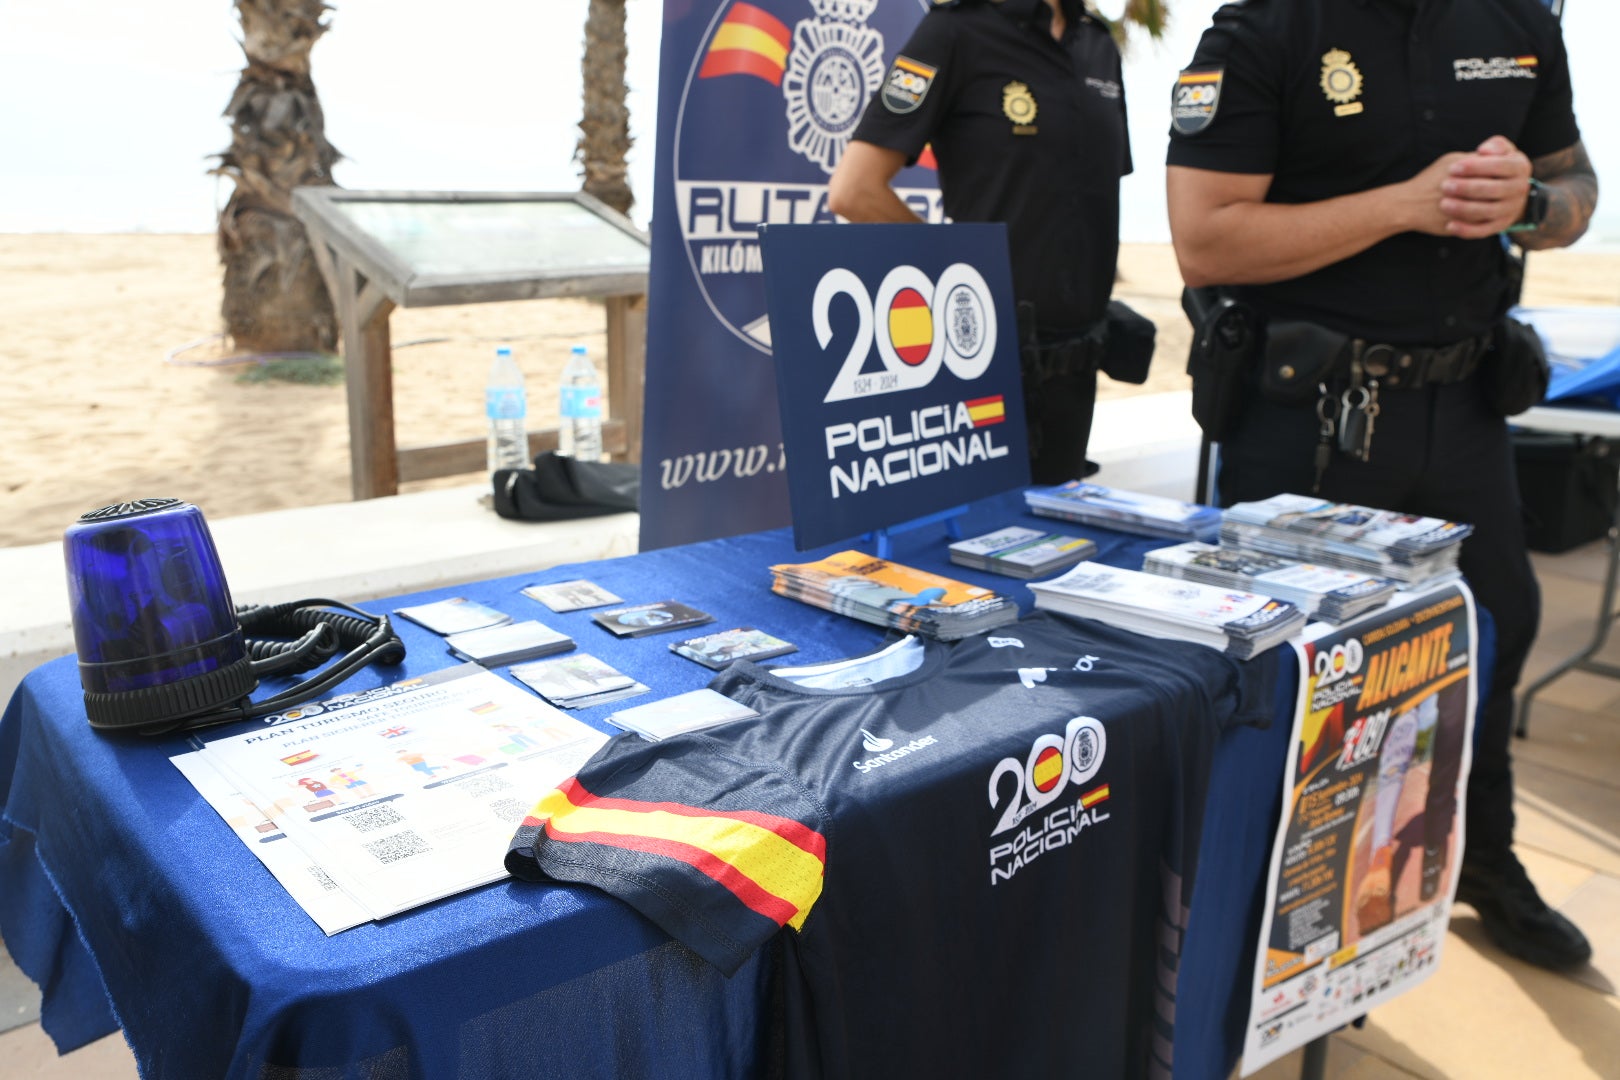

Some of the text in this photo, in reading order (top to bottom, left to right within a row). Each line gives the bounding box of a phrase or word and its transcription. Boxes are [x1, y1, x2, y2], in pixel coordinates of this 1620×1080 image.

[891, 69, 928, 94] 200
[1177, 84, 1217, 106] 200
[1455, 67, 1537, 81] NACIONAL
[812, 262, 997, 403] 200
[830, 431, 1009, 498] NACIONAL
[1314, 638, 1364, 689] 200
[1356, 622, 1454, 712] ALICANTE
[245, 688, 448, 744] PLAN TURISMO SEGURO
[264, 704, 325, 726] 200
[327, 683, 429, 711] NACIONAL
[1311, 688, 1363, 712] NACIONAL
[852, 734, 938, 774] Santander
[988, 716, 1107, 838] 200
[991, 808, 1110, 886] NACIONAL
